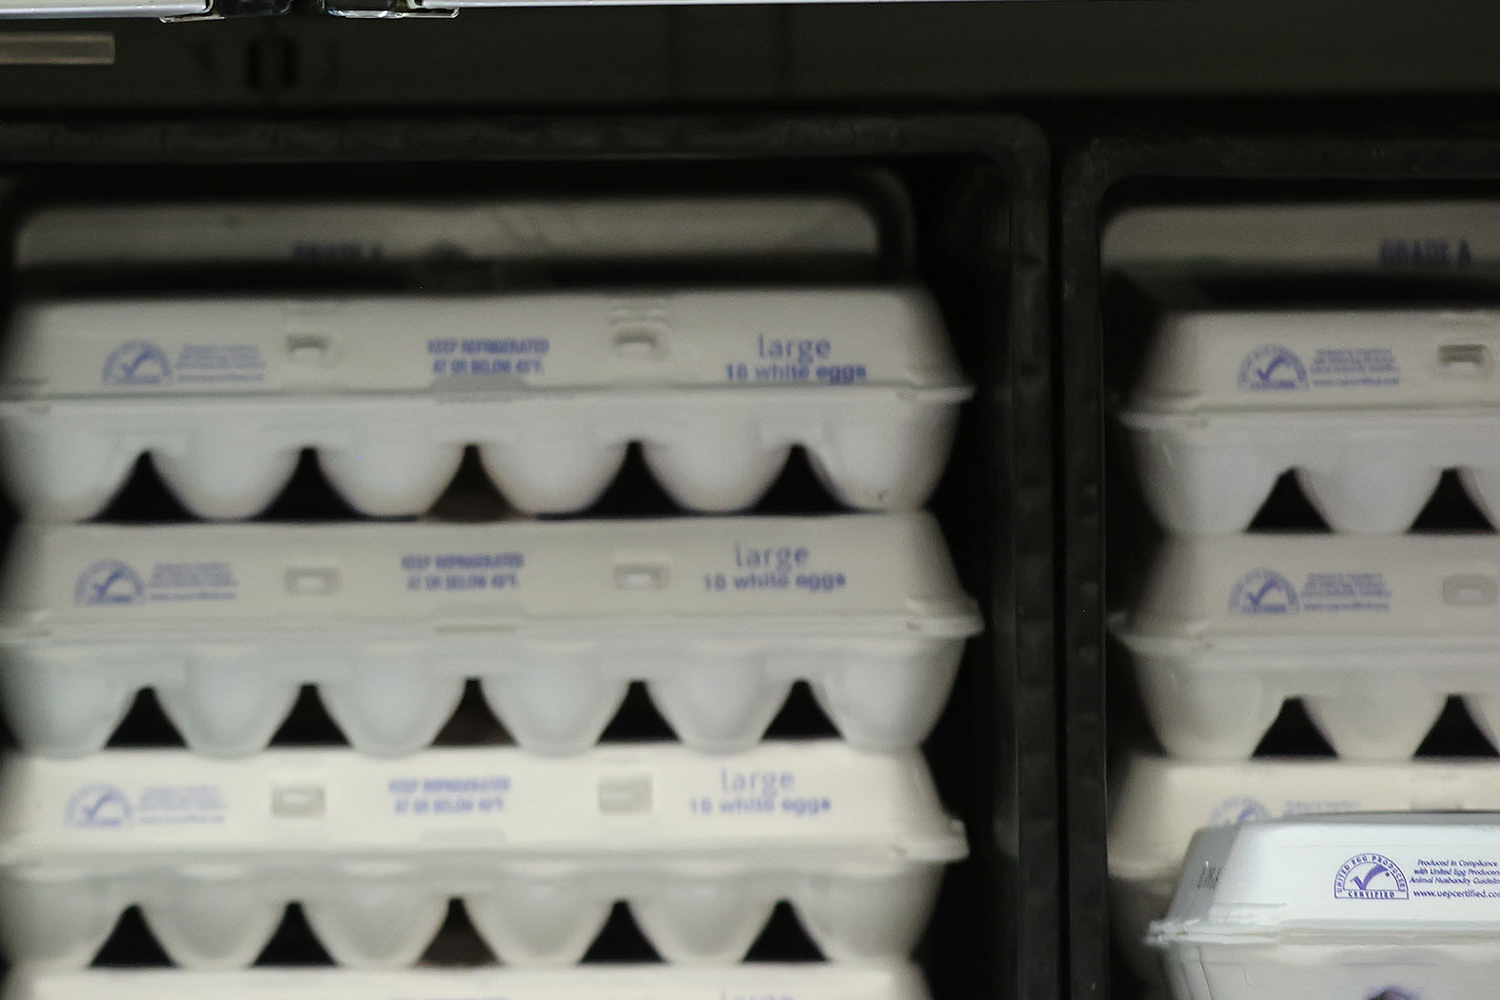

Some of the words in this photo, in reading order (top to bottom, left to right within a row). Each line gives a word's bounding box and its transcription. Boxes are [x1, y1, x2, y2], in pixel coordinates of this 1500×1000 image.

[759, 334, 831, 363] large
[735, 543, 809, 571] large
[721, 768, 794, 795] large
[1459, 860, 1498, 868] Compliance
[1435, 877, 1470, 885] Husbandry
[1413, 890, 1500, 898] www.uepcertified.co
